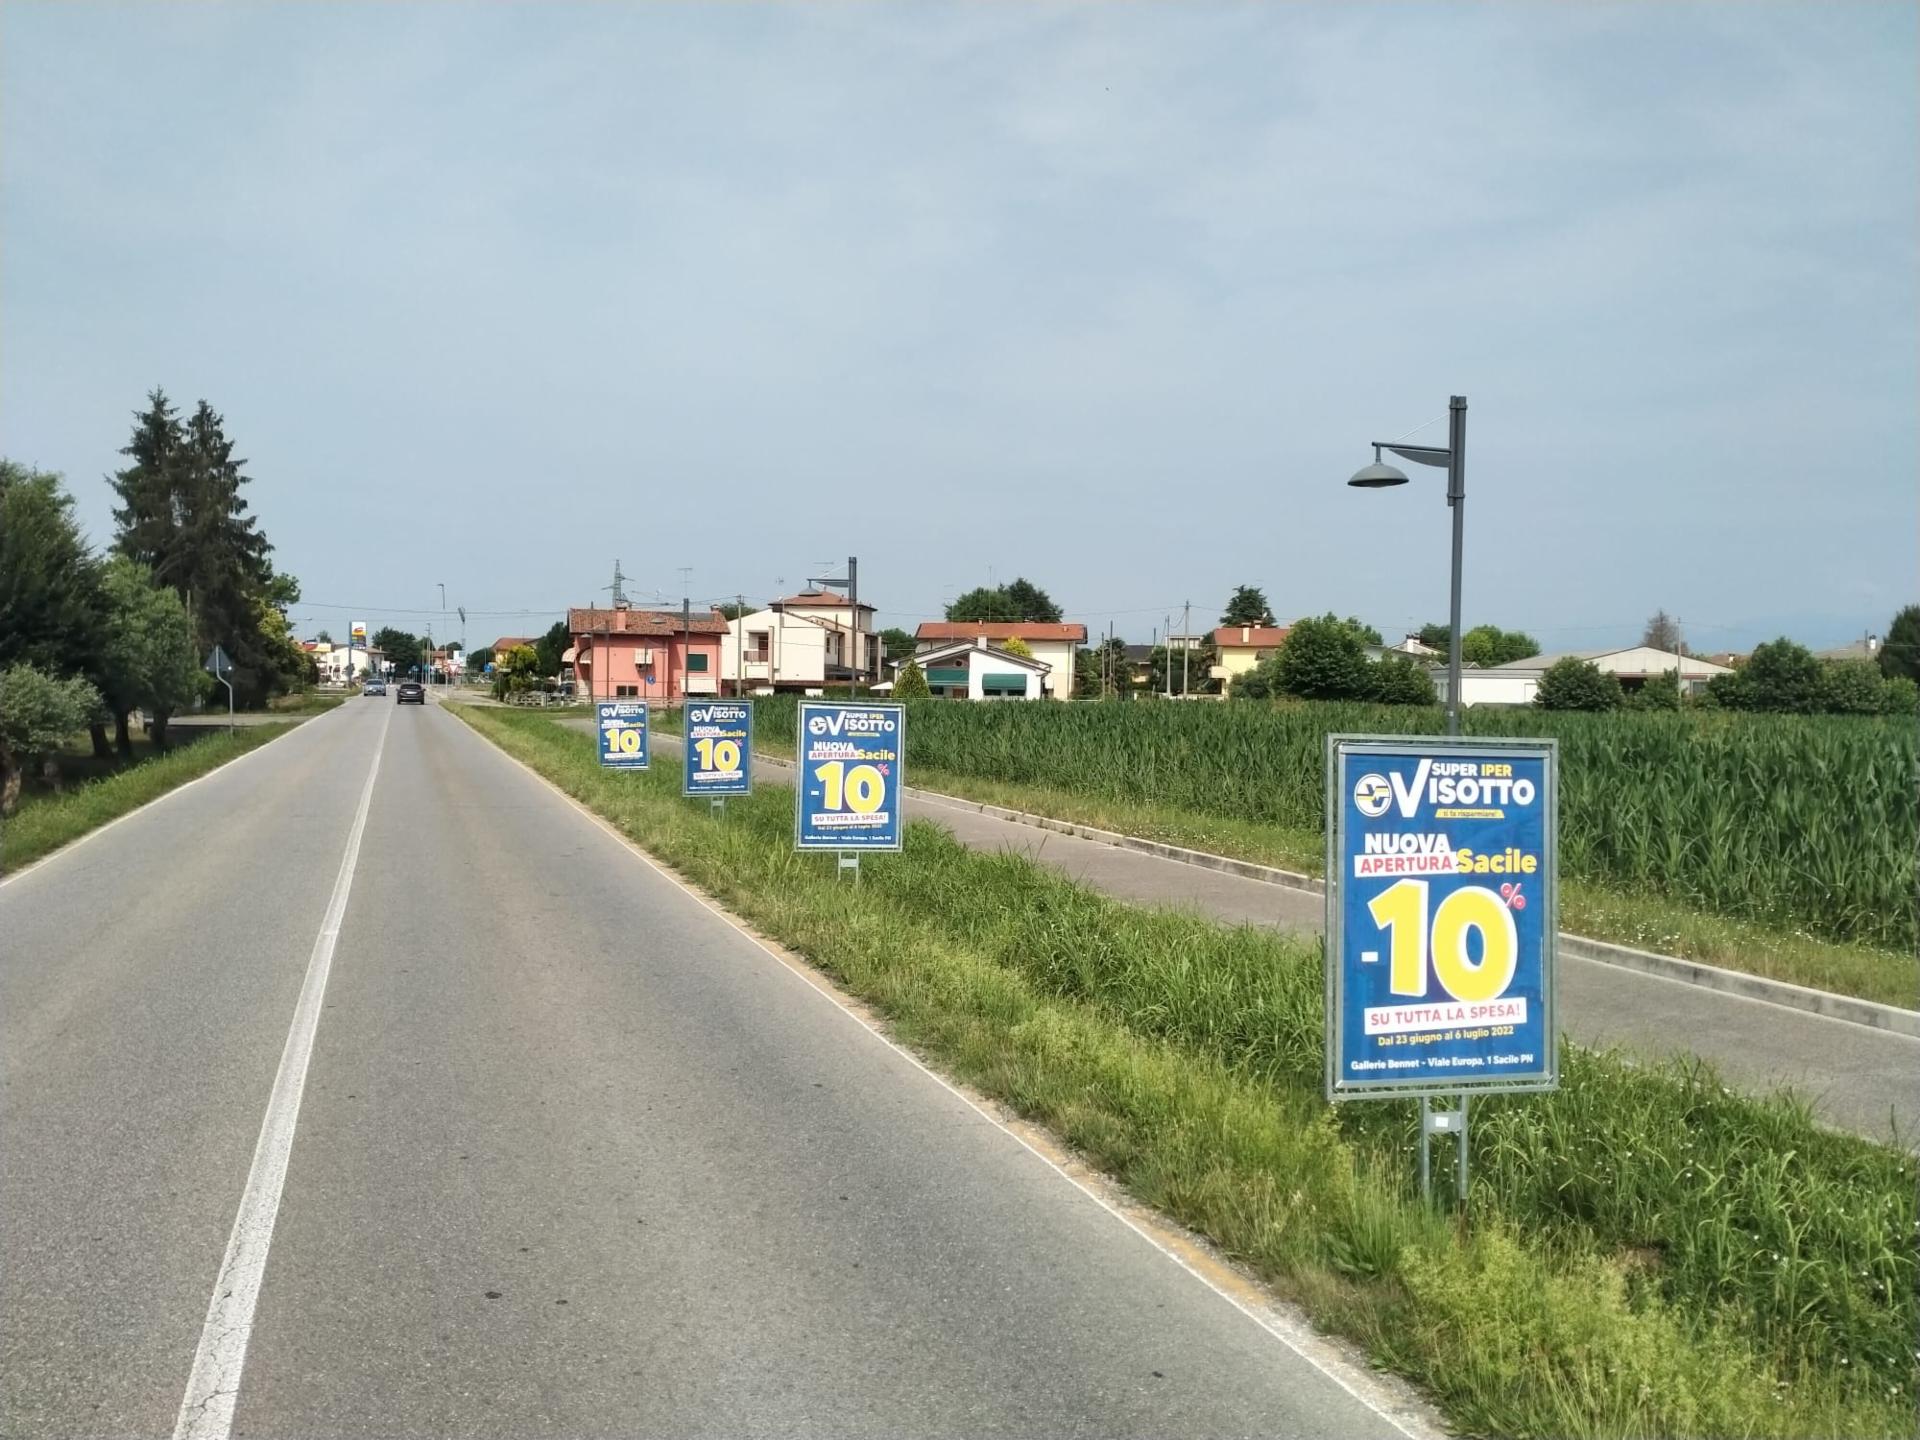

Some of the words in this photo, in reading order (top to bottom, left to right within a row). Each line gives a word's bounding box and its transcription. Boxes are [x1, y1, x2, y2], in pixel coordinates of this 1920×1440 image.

[701, 705, 746, 722] VISOTTO
[825, 711, 896, 736] VISOTTO
[811, 751, 856, 759] APERTURA
[857, 749, 896, 760] Sacile
[813, 741, 855, 751] NUOVA
[1431, 763, 1478, 776] SUPER
[1481, 764, 1512, 777] IPER
[1389, 759, 1535, 818] VISOTTO
[1364, 833, 1450, 853] NUOVA
[1360, 856, 1453, 874] APERTURA
[1456, 848, 1537, 873] Sacile
[1371, 1013, 1390, 1026] SU
[1395, 1009, 1442, 1024] TUTTA
[1447, 1007, 1465, 1020] LA
[1470, 1003, 1520, 1019] SPESA!
[1378, 1035, 1393, 1046] Dal
[1396, 1034, 1408, 1044] 23
[1409, 1032, 1442, 1045] giugno
[1444, 1031, 1453, 1040] al
[1455, 1031, 1461, 1040] 6
[1463, 1028, 1489, 1041] luglio
[1491, 1025, 1514, 1037] 2022
[1351, 1059, 1386, 1070] Gallerie
[1387, 1059, 1420, 1069] Bennet
[1427, 1057, 1450, 1067] Viale
[1451, 1056, 1485, 1067] Europa,
[1487, 1055, 1492, 1064] 1
[1493, 1054, 1519, 1064] Sacile
[1520, 1053, 1534, 1063] PN
